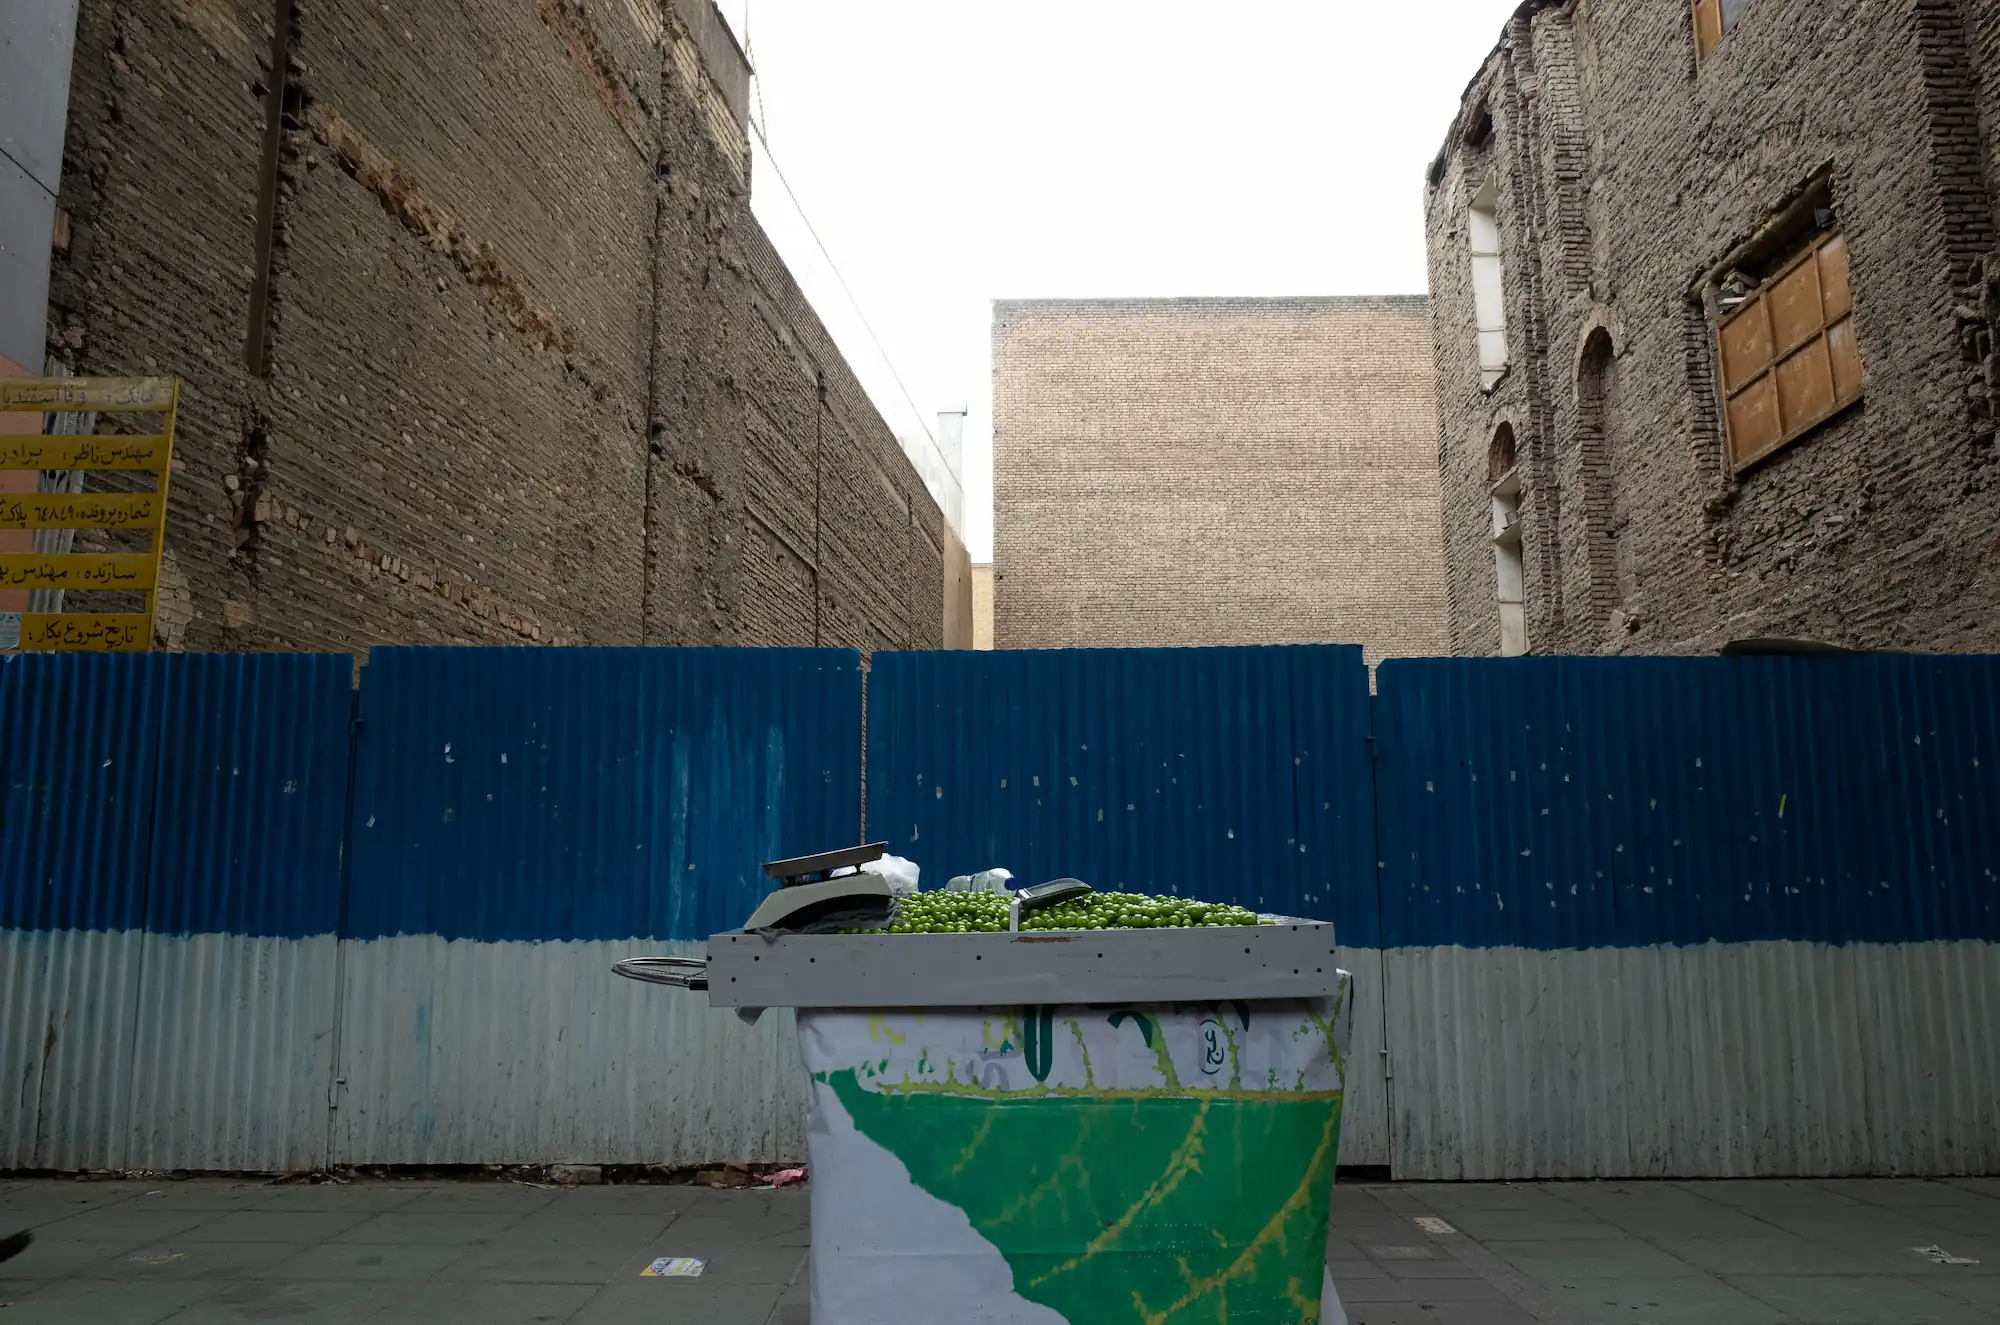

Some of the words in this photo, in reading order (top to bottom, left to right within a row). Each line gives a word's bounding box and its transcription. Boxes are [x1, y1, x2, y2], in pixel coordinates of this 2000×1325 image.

[101, 446, 153, 465] مهندس
[117, 500, 151, 523] شماره
[12, 564, 67, 584] مهندس
[64, 621, 103, 645] شروع
[105, 619, 137, 648] تاریخ
